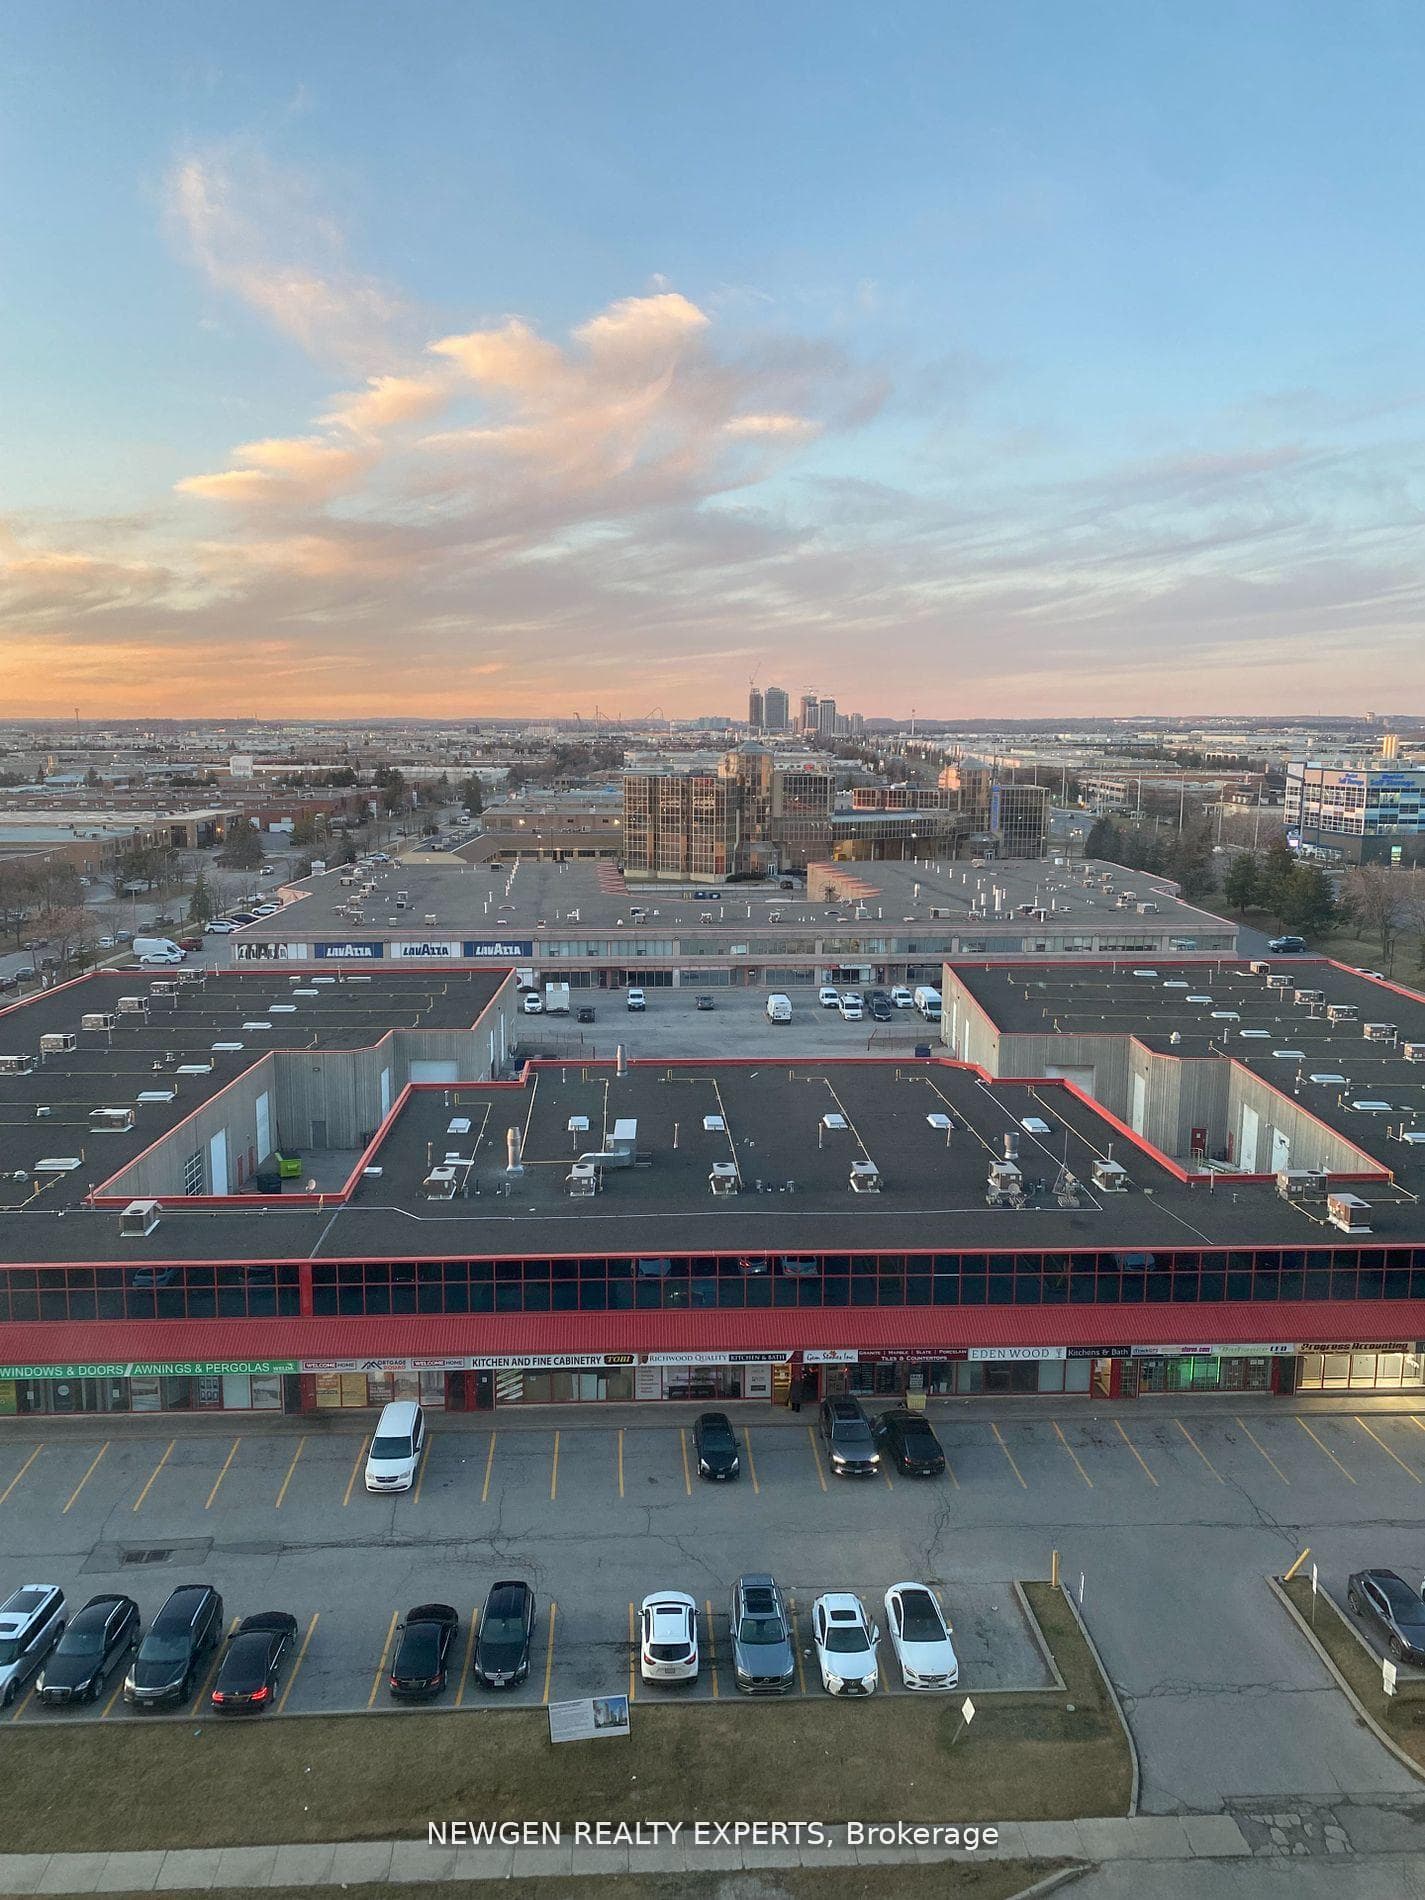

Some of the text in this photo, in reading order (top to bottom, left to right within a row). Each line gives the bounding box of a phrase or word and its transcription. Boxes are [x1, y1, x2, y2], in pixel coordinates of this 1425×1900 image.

[326, 944, 372, 957] LAVAZZA
[403, 944, 449, 956] LAVAZZA
[475, 943, 521, 955] LAVAZZA
[1352, 1342, 1408, 1350] Accounting
[472, 1355, 602, 1367] KITCHEN AND FINE CABINETRY
[0, 1365, 124, 1377] WINDOWS & DOORS
[134, 1363, 269, 1374] AWNINGS & PERGOLAS
